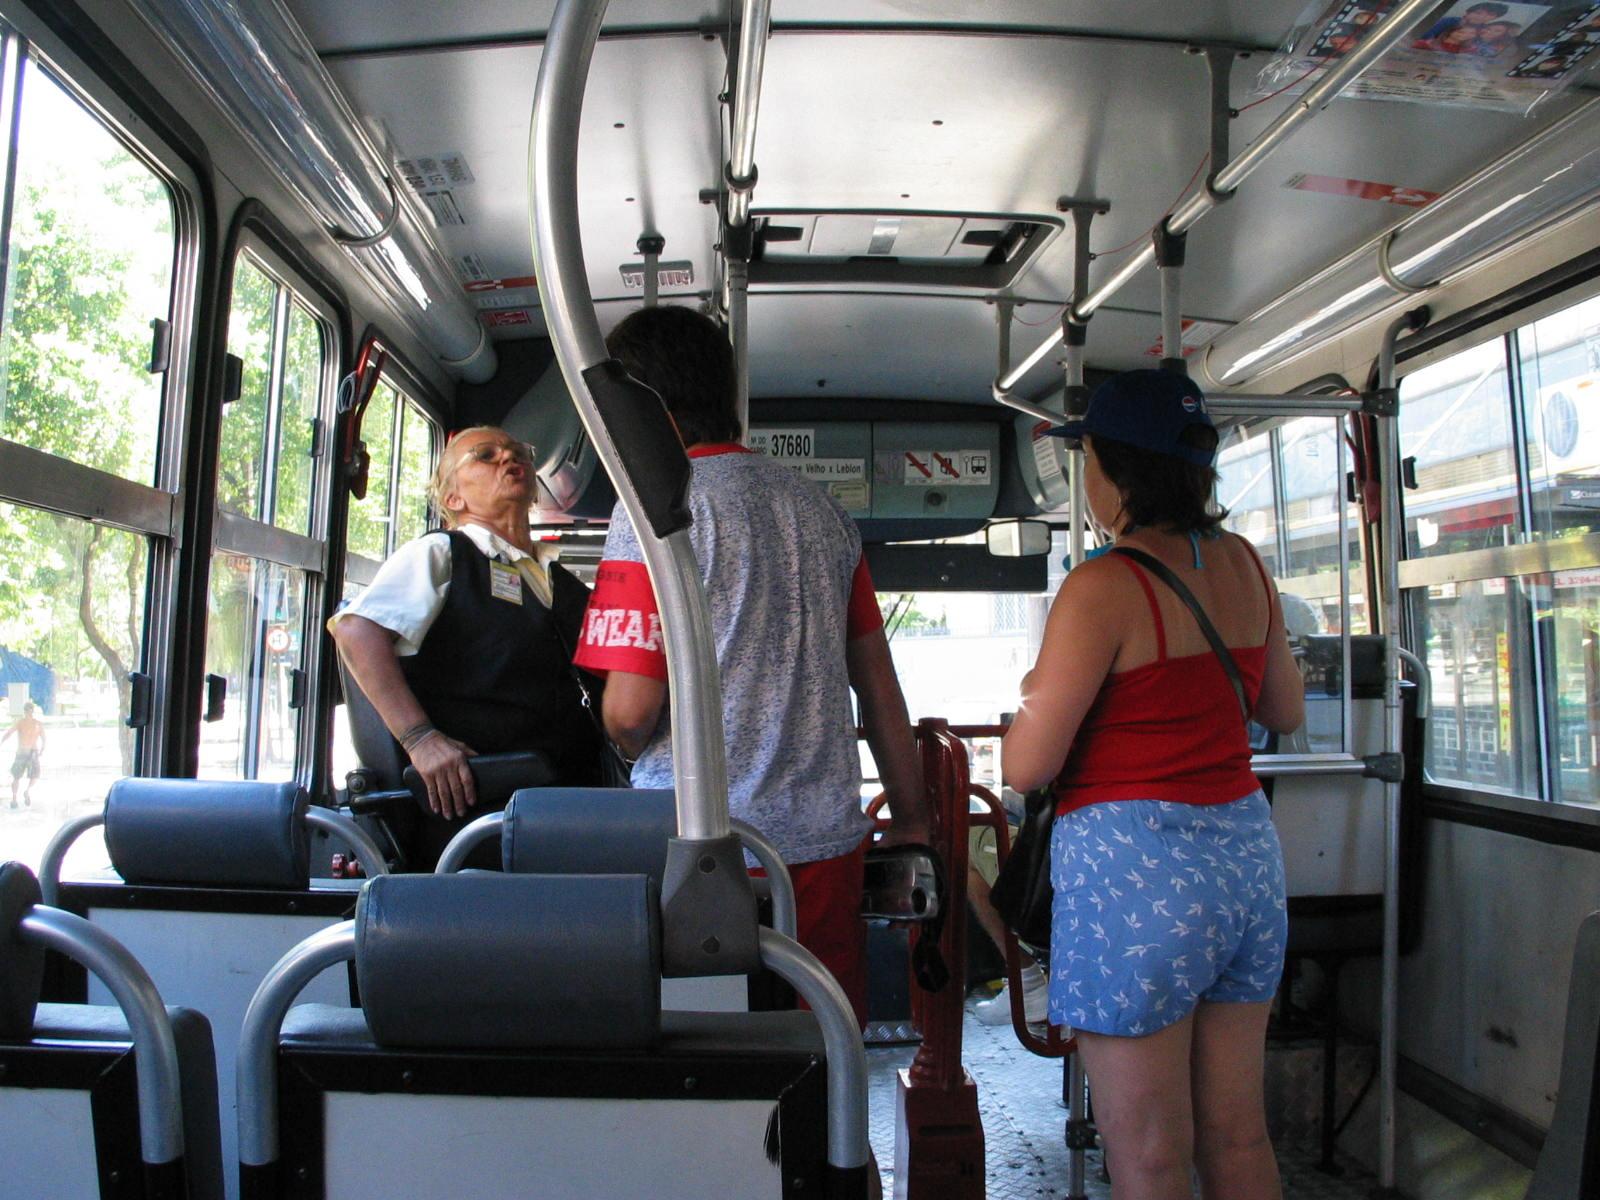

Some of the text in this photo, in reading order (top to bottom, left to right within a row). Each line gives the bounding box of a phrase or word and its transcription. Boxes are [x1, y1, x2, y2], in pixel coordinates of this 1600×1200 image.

[771, 434, 810, 456] 37680
[805, 463, 825, 472] Velho
[836, 463, 861, 472] Leblon
